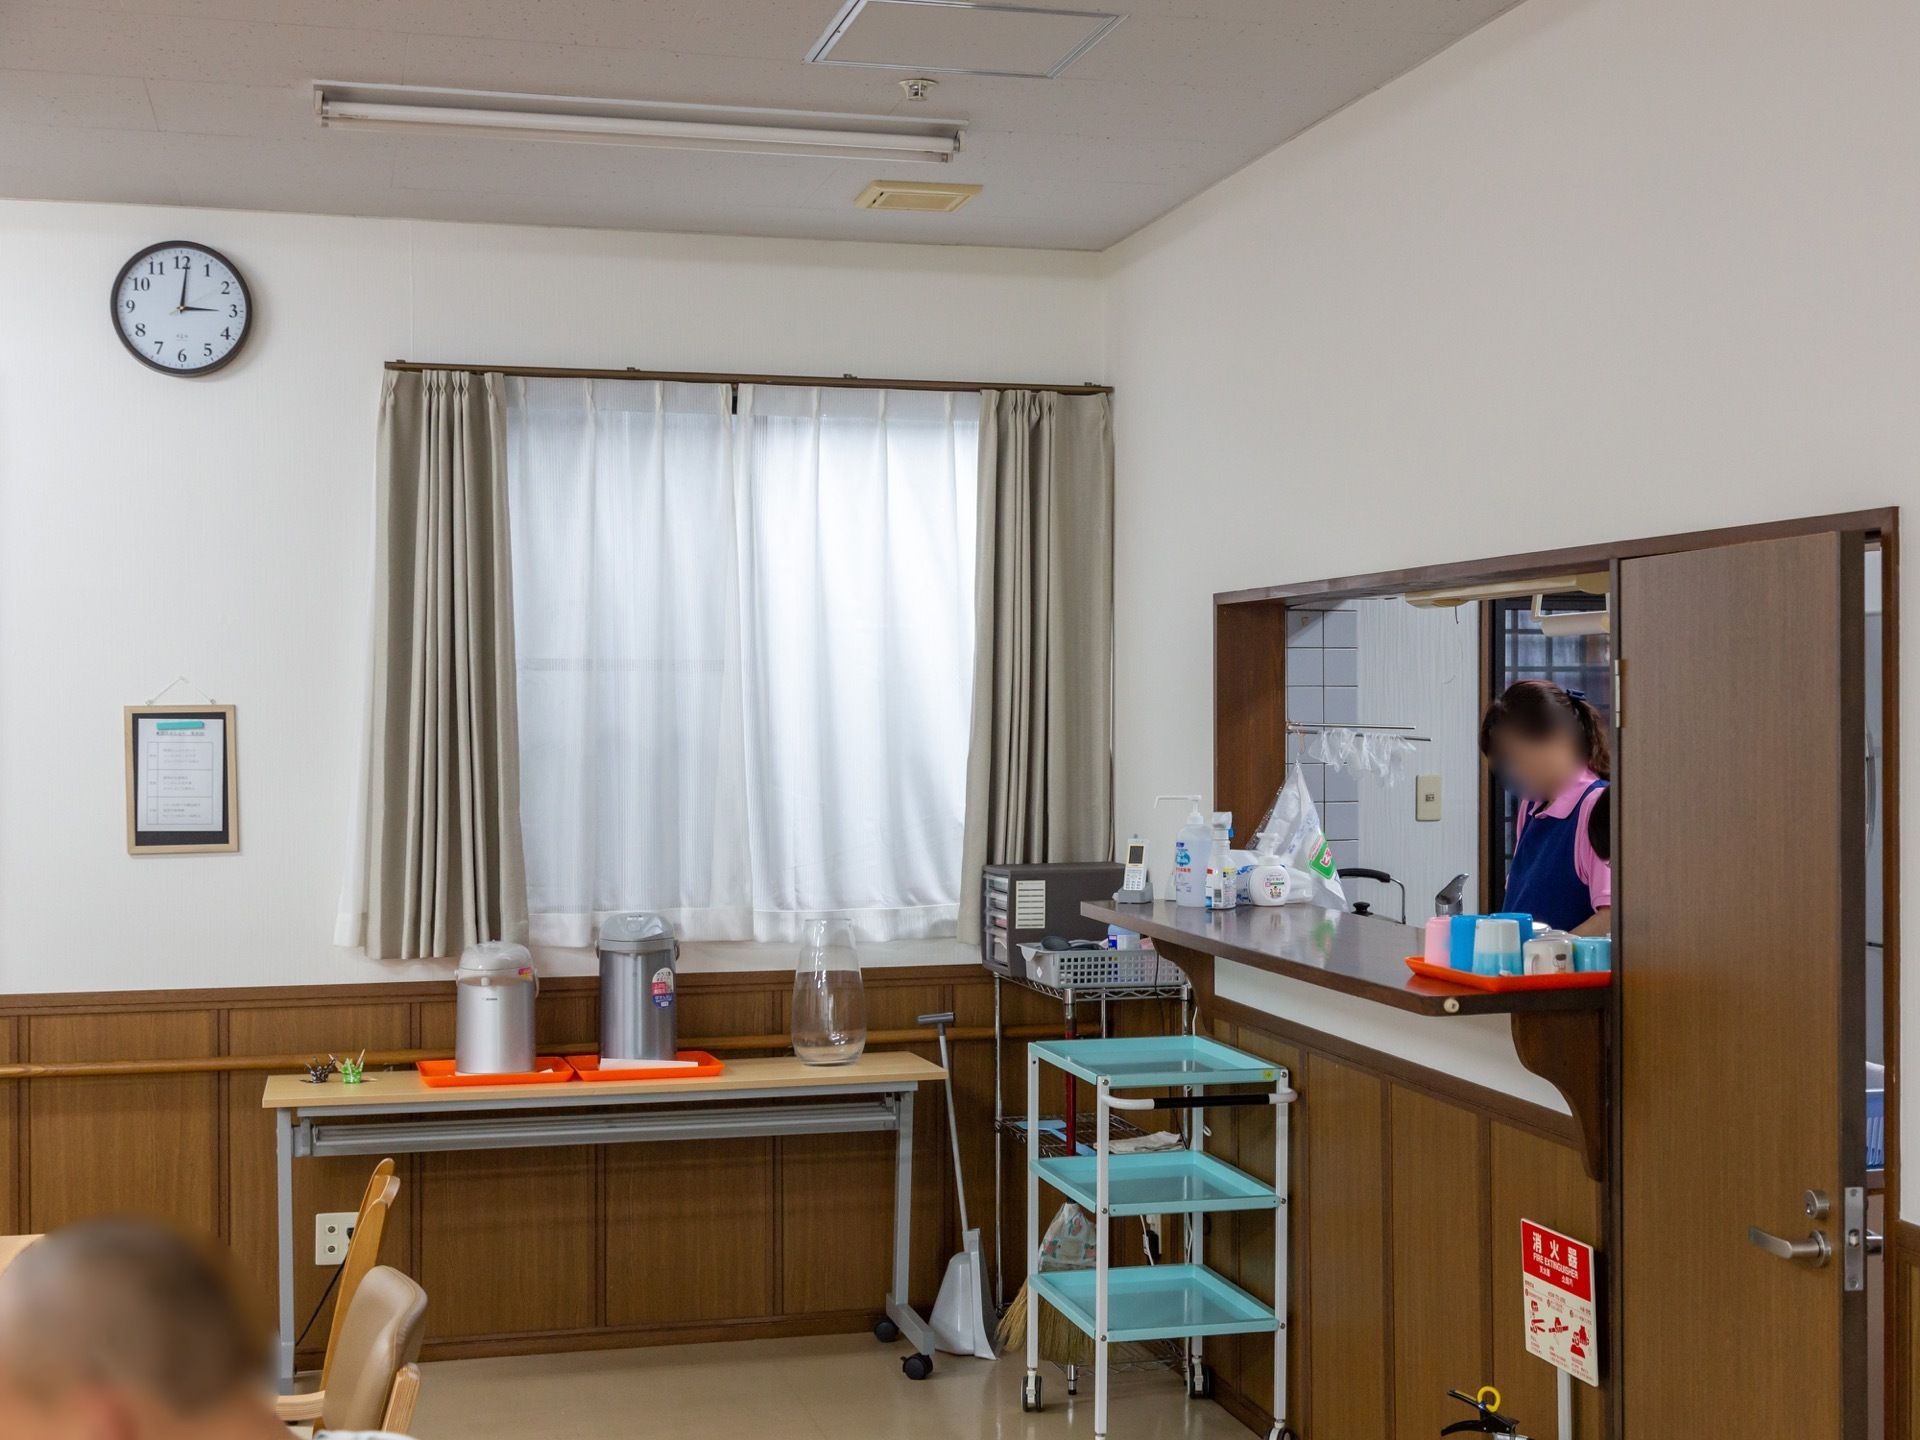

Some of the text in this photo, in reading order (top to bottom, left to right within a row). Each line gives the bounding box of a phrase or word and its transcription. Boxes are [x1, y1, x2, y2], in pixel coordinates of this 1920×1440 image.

[150, 261, 165, 275] 11
[174, 255, 191, 270] 12
[204, 263, 211, 277] 1
[133, 277, 150, 291] 10
[221, 281, 230, 295] 2
[126, 300, 136, 314] 9
[229, 304, 238, 318] 3
[135, 323, 146, 337] 8
[220, 326, 231, 340] 4
[154, 341, 164, 355] 7
[203, 343, 213, 357] 5
[177, 349, 187, 363] 6
[1532, 1231, 1578, 1270] 消火器
[1533, 1252, 1579, 1280] FIRE EXTINGUISHER
